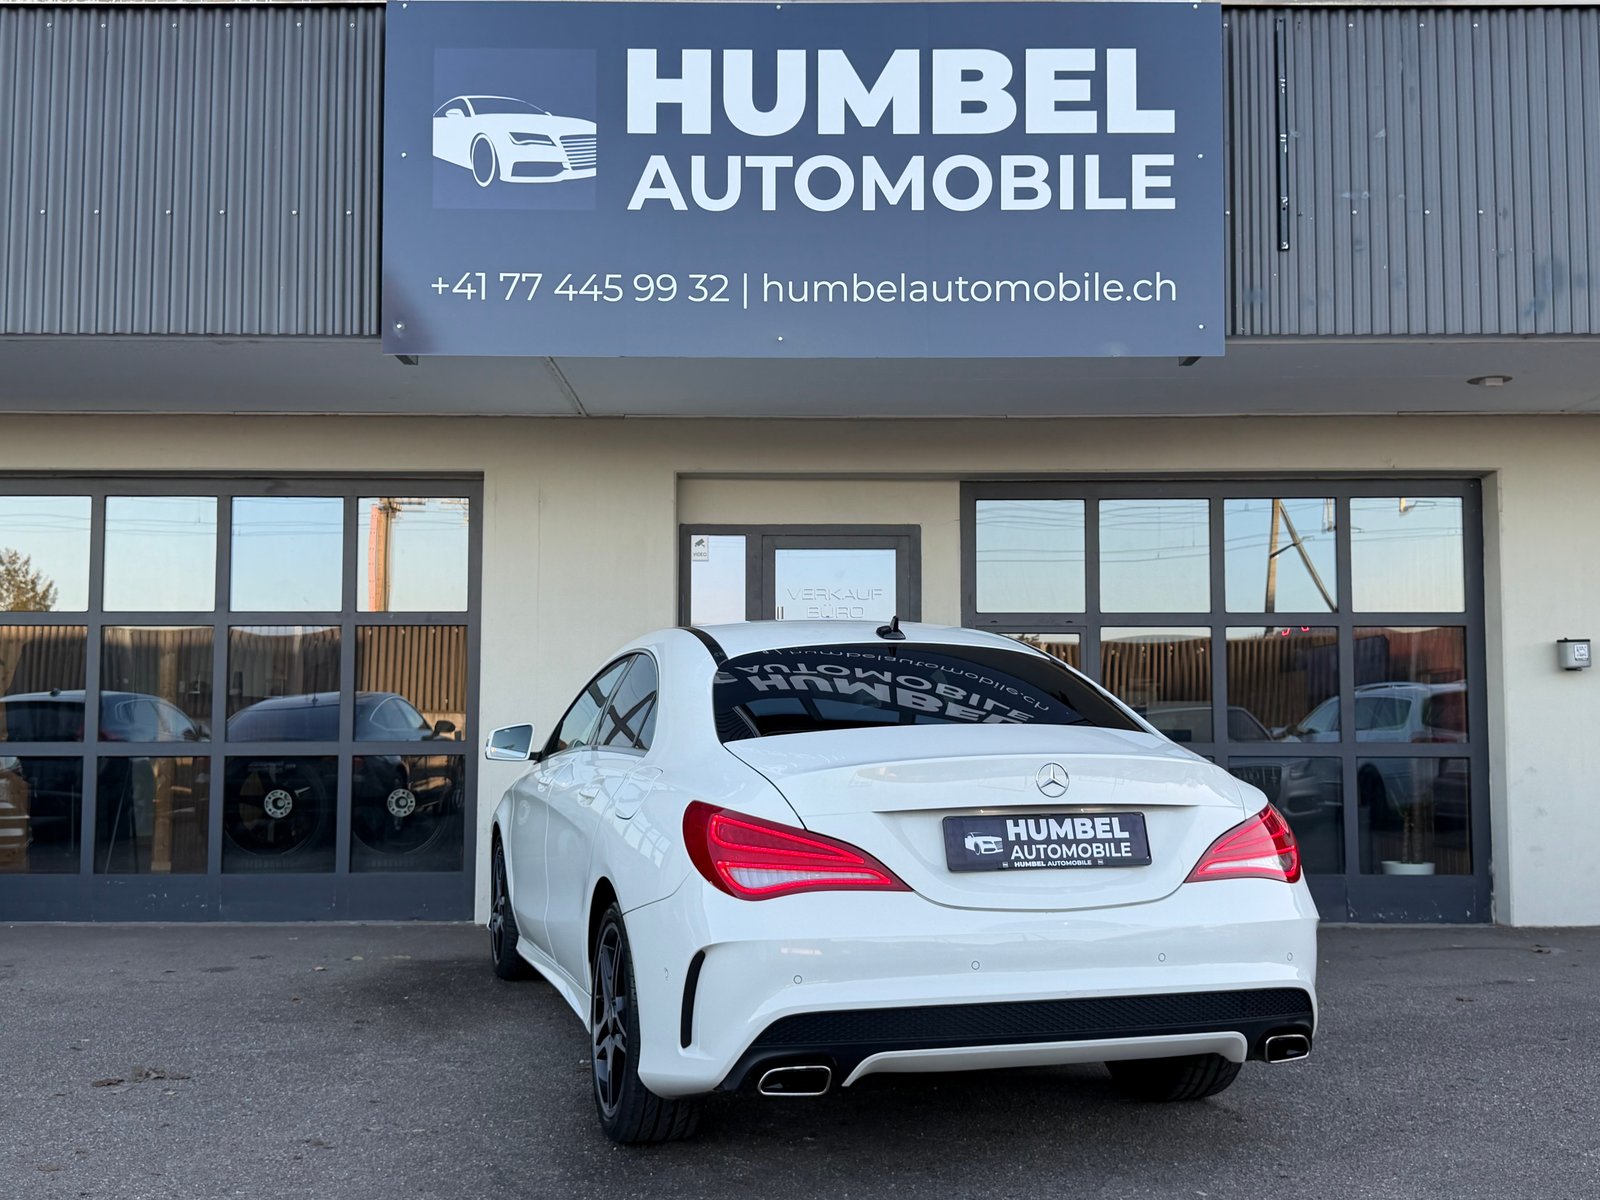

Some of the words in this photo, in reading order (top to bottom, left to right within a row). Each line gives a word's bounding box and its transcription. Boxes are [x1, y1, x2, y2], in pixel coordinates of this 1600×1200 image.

[626, 47, 1177, 137] HUMBEL
[627, 153, 1177, 213] AUTOMOBILE
[431, 272, 487, 301] +41
[499, 272, 543, 301] 77
[553, 273, 624, 302] 445
[632, 273, 678, 302] 99
[687, 273, 730, 302] 32
[762, 271, 1178, 303] humbelautomobile.ch
[786, 588, 883, 601] VERKAUF
[806, 603, 865, 619] BÜRO
[1006, 817, 1129, 841] HUMBEL
[1010, 842, 1133, 860] AUTOMOBILE
[1047, 859, 1092, 867] AUTOMOBILE
